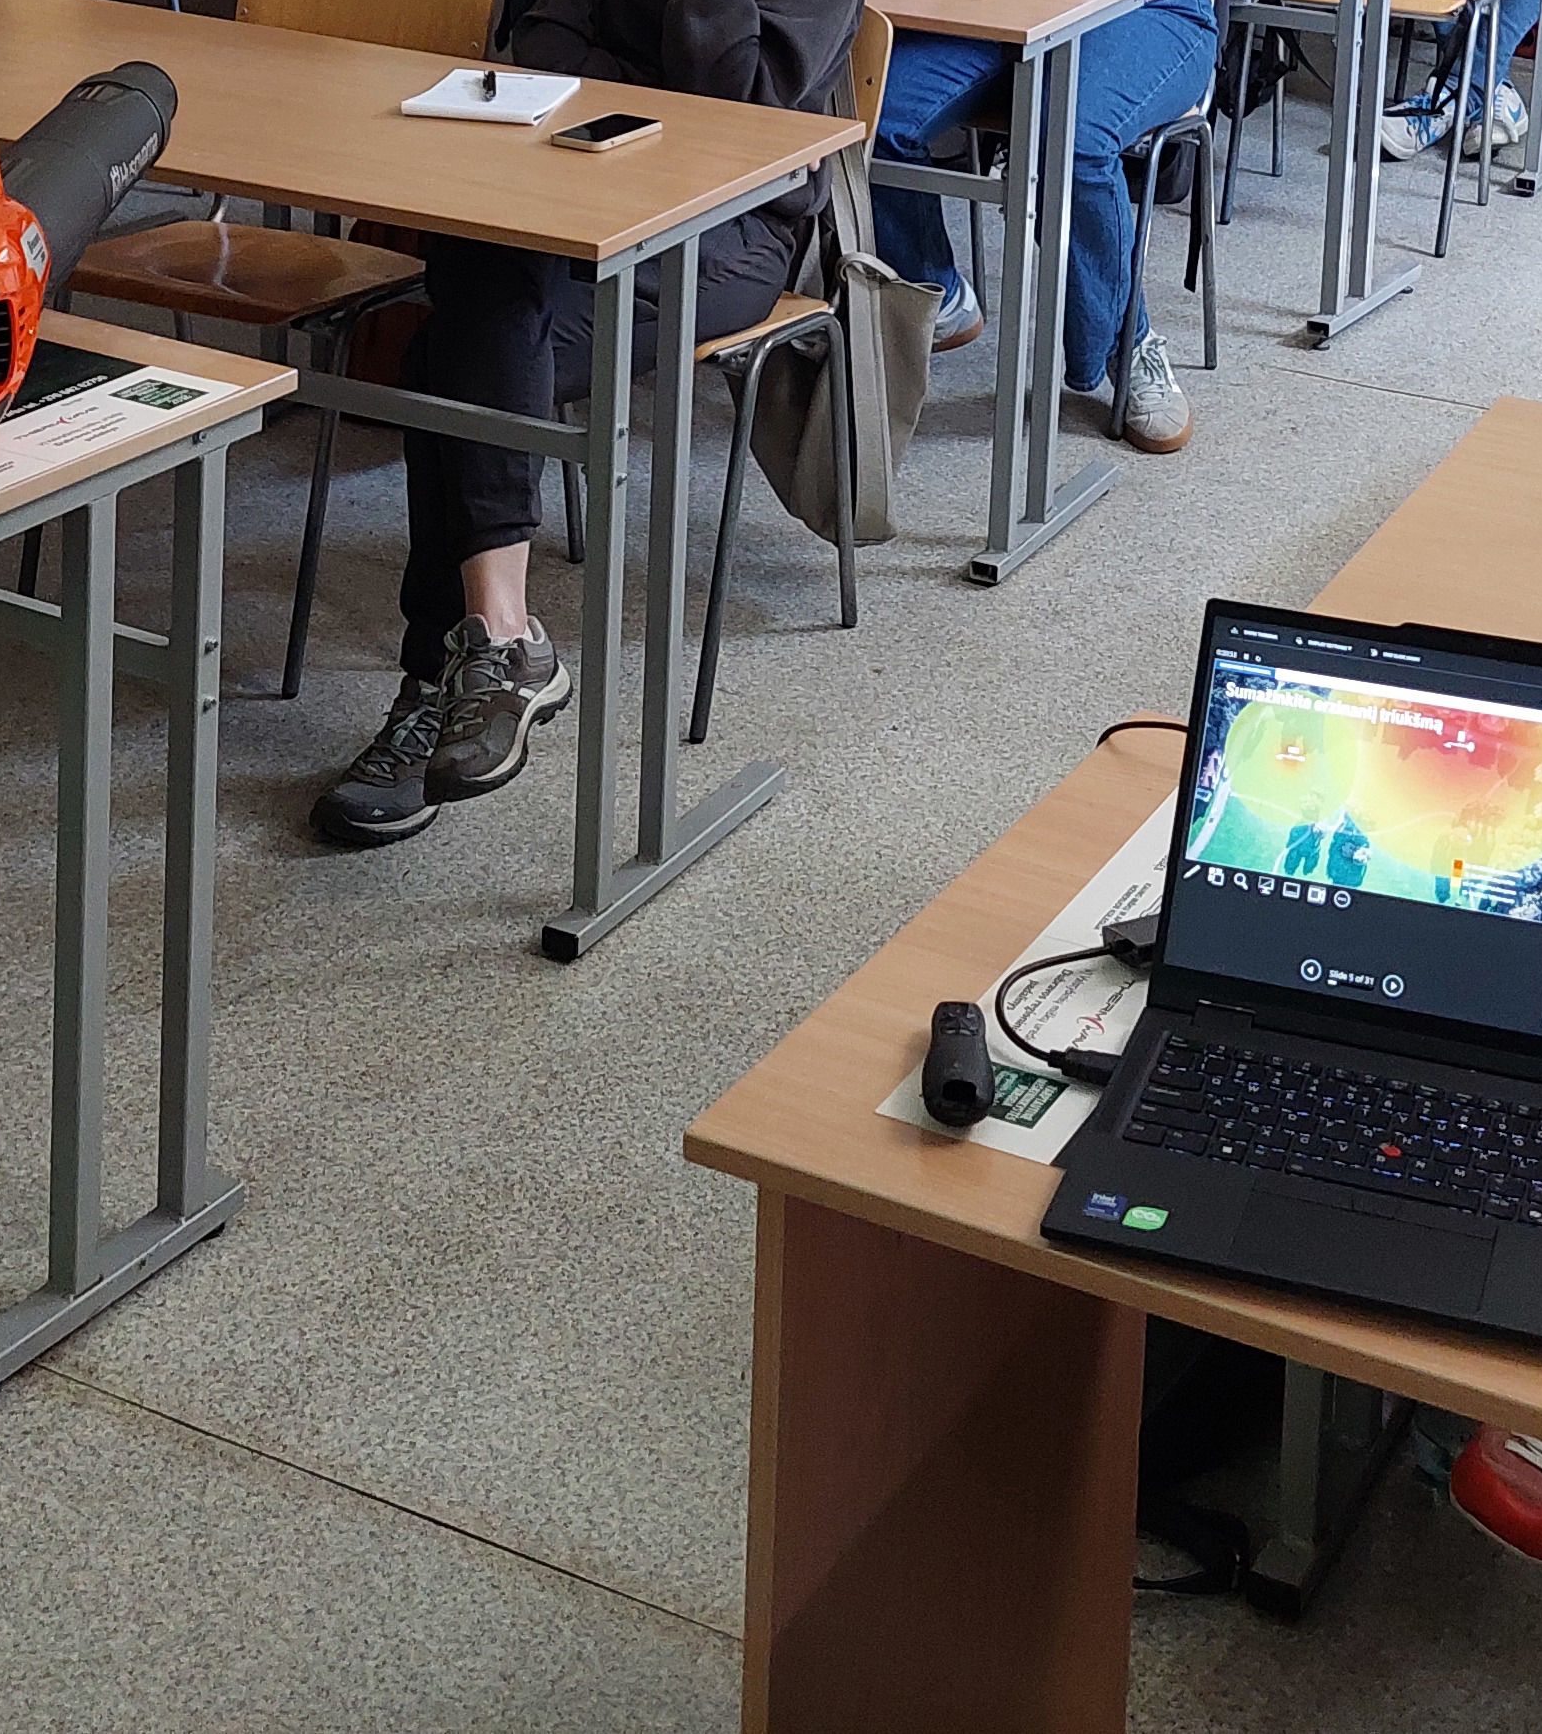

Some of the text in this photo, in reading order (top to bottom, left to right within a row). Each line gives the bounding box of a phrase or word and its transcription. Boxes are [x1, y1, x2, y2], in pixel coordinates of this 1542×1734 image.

[1225, 681, 1312, 711] Sumažinkite
[1379, 705, 1444, 736] triukšmą
[1328, 969, 1348, 981] Slide
